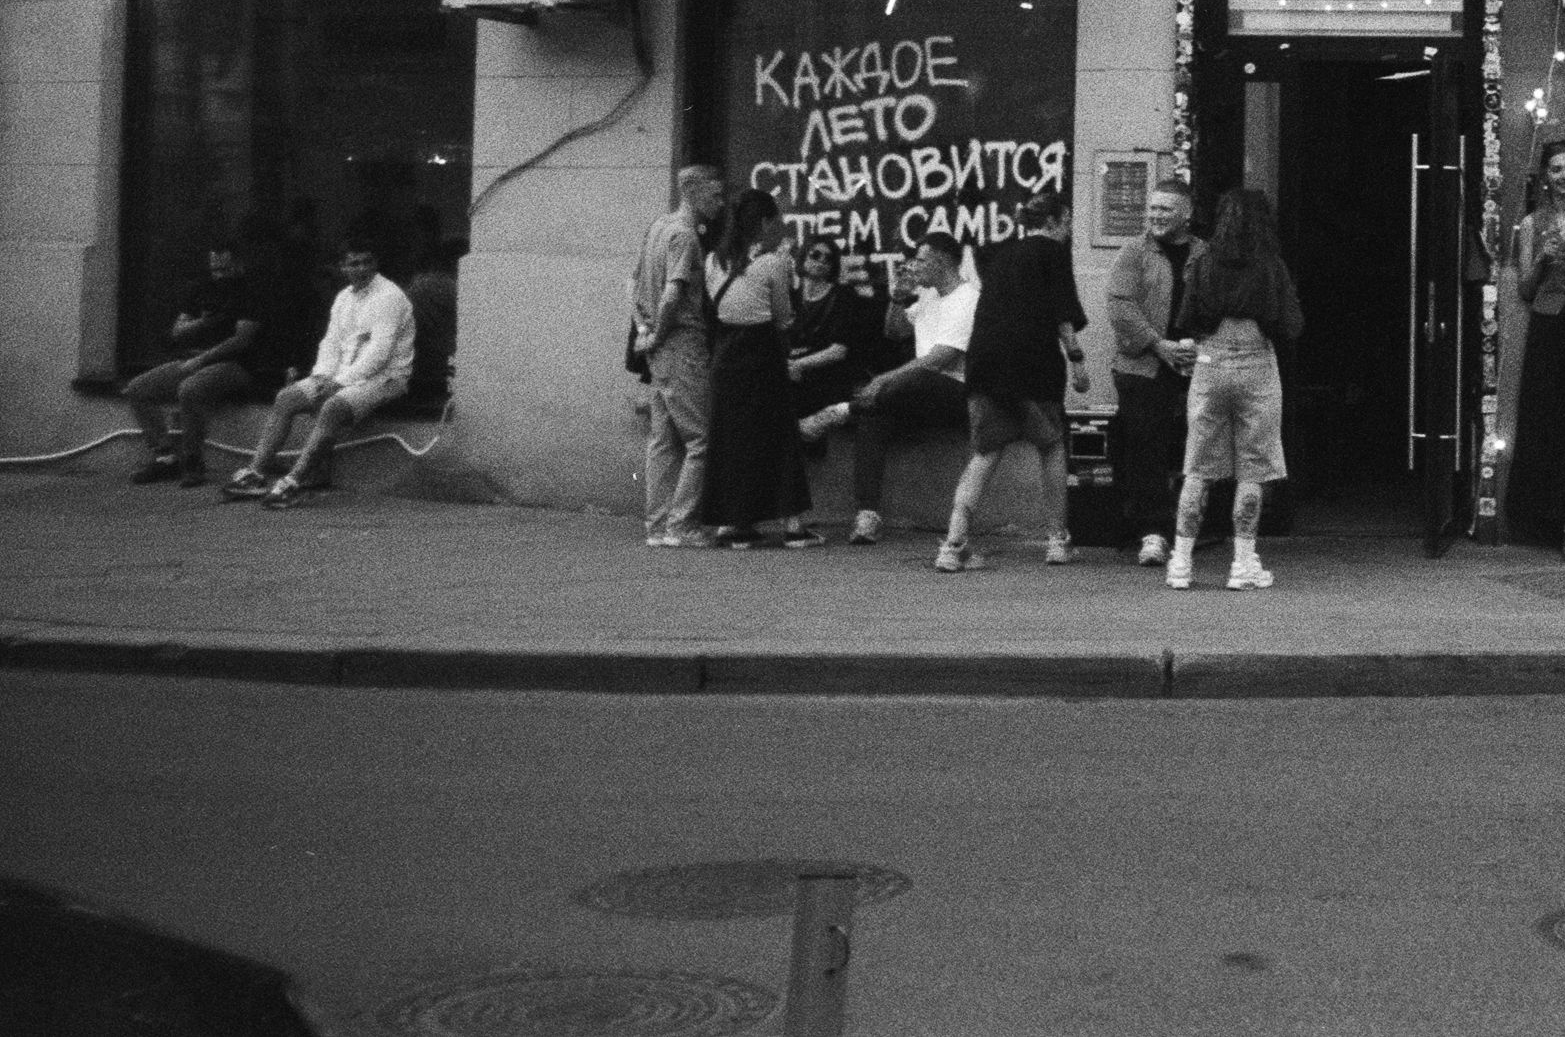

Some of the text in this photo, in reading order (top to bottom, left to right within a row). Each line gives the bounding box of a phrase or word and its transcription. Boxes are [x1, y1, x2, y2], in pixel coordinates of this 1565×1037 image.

[755, 35, 969, 108] КАЖДОЕ
[801, 94, 936, 160] ЛЕТО
[750, 139, 1067, 205] СТАНОВИТСЯ
[782, 200, 1026, 252] ТЕМ САМЫ
